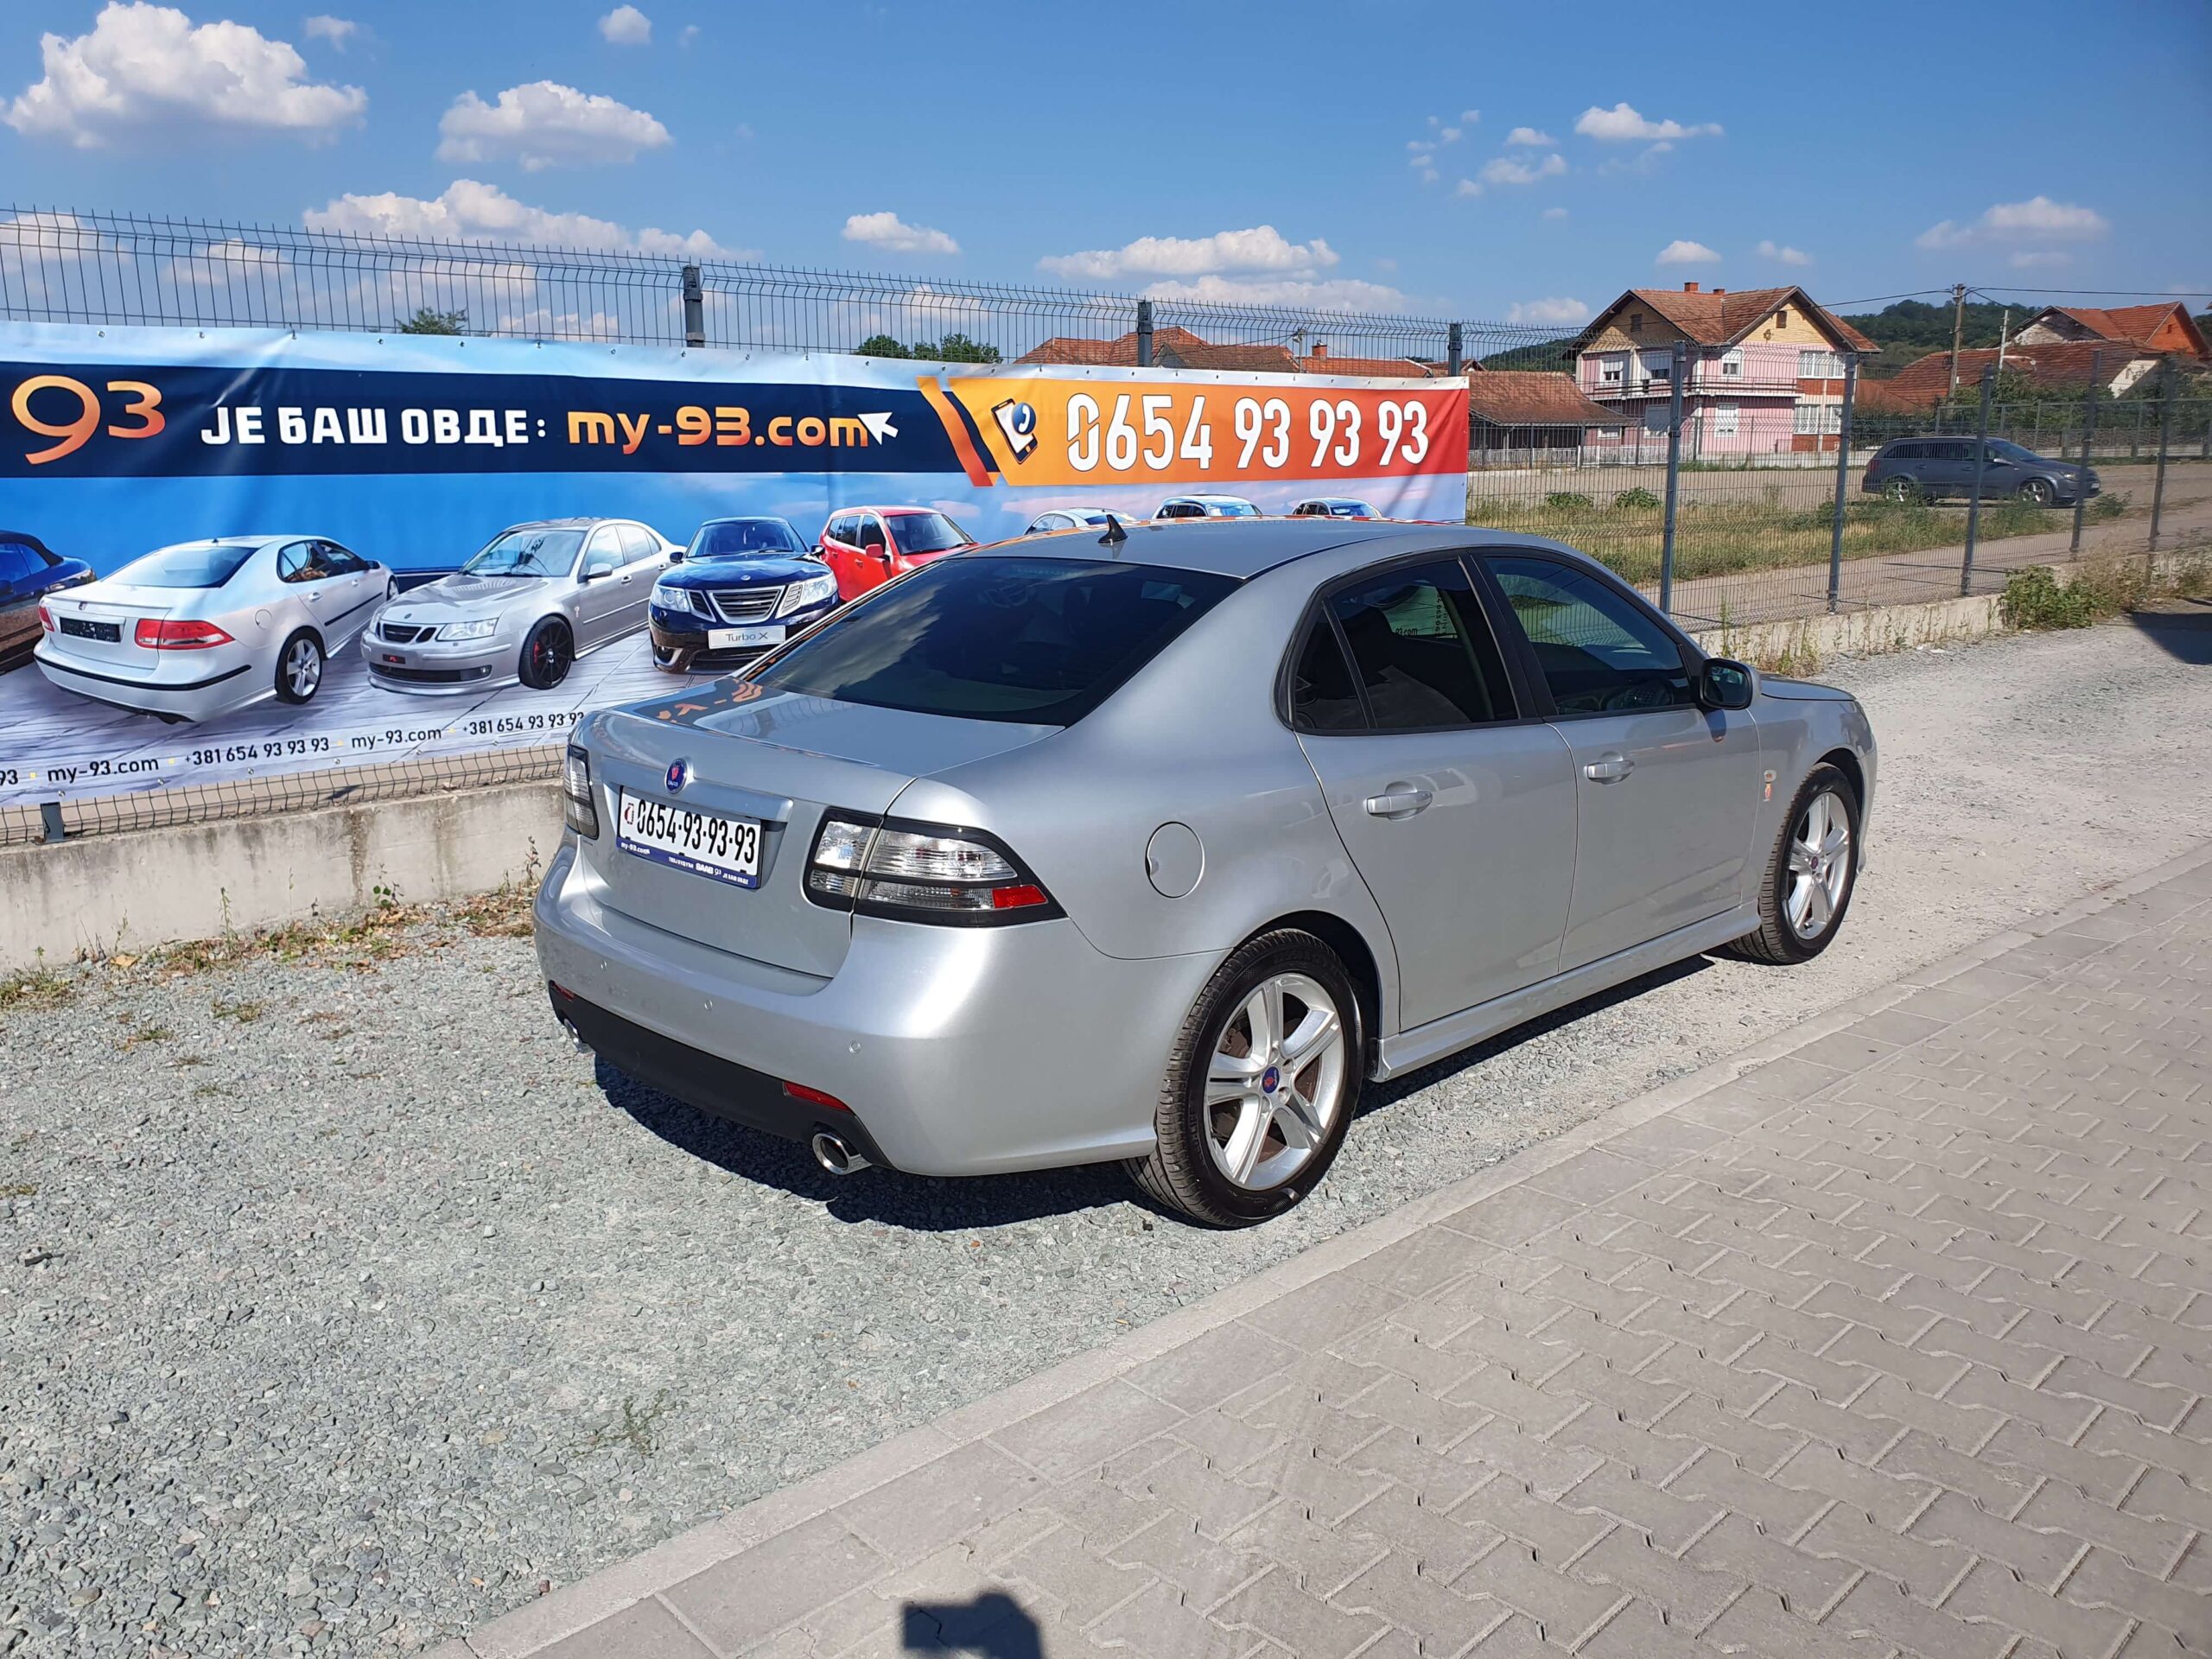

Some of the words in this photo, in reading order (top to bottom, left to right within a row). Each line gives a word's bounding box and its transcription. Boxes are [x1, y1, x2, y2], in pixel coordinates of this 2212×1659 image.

[11, 375, 167, 466] 93
[200, 407, 265, 445] ЈЕ
[277, 406, 389, 446] БАШ
[401, 407, 546, 448] ОВДЕ:
[567, 405, 869, 455] my-93.com
[1066, 392, 1212, 472] 0654
[1234, 396, 1291, 469] 93
[1309, 398, 1362, 468] 93
[1377, 399, 1429, 466] 93
[725, 632, 756, 642] Turbo
[759, 632, 768, 640] X
[48, 758, 159, 784] my-93.com
[185, 748, 222, 766] +381
[226, 744, 258, 762] 654
[264, 742, 283, 758] 93
[287, 739, 306, 755] 93
[311, 737, 330, 753] 93
[352, 728, 442, 750] my-93.com
[462, 719, 494, 735] +381
[497, 716, 524, 733] 654
[528, 715, 543, 730] 93
[548, 713, 564, 728] 93
